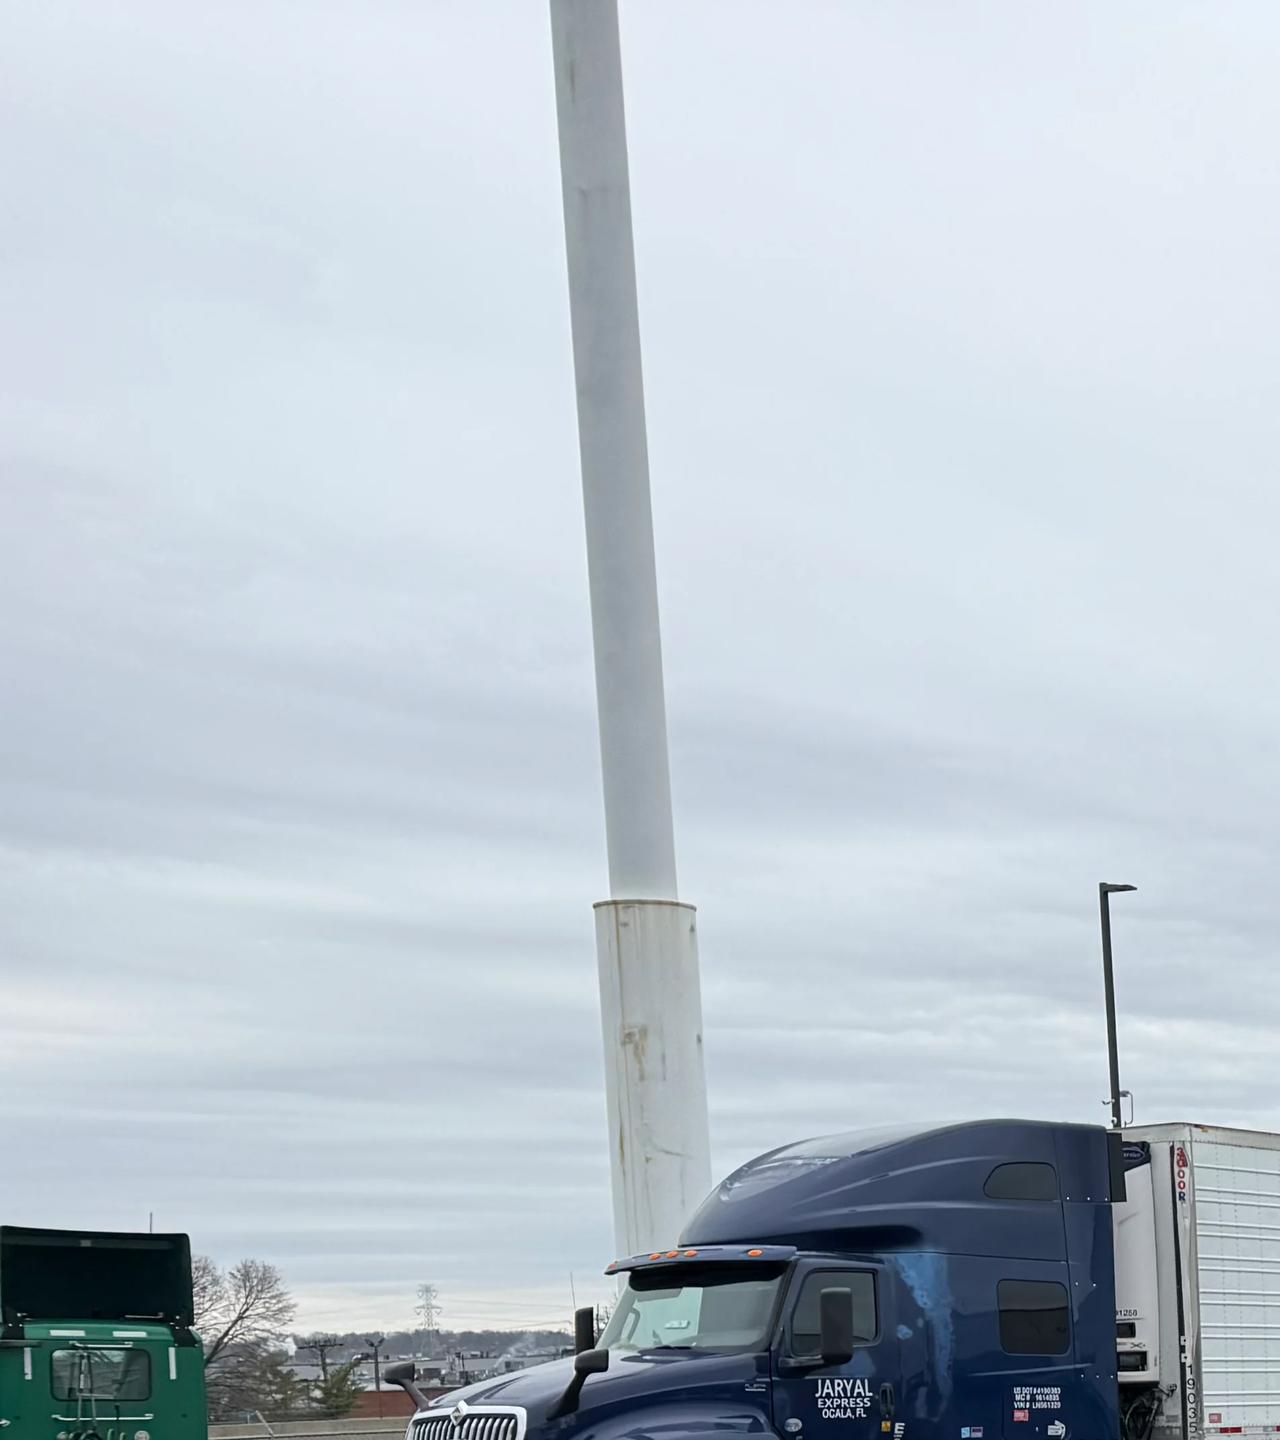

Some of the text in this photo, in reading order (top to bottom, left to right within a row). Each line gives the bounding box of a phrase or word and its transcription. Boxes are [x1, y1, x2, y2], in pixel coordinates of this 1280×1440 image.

[815, 1378, 874, 1398] JARYAL
[817, 1398, 872, 1409] EXPRESS
[822, 1407, 867, 1419] OCALA, FL
